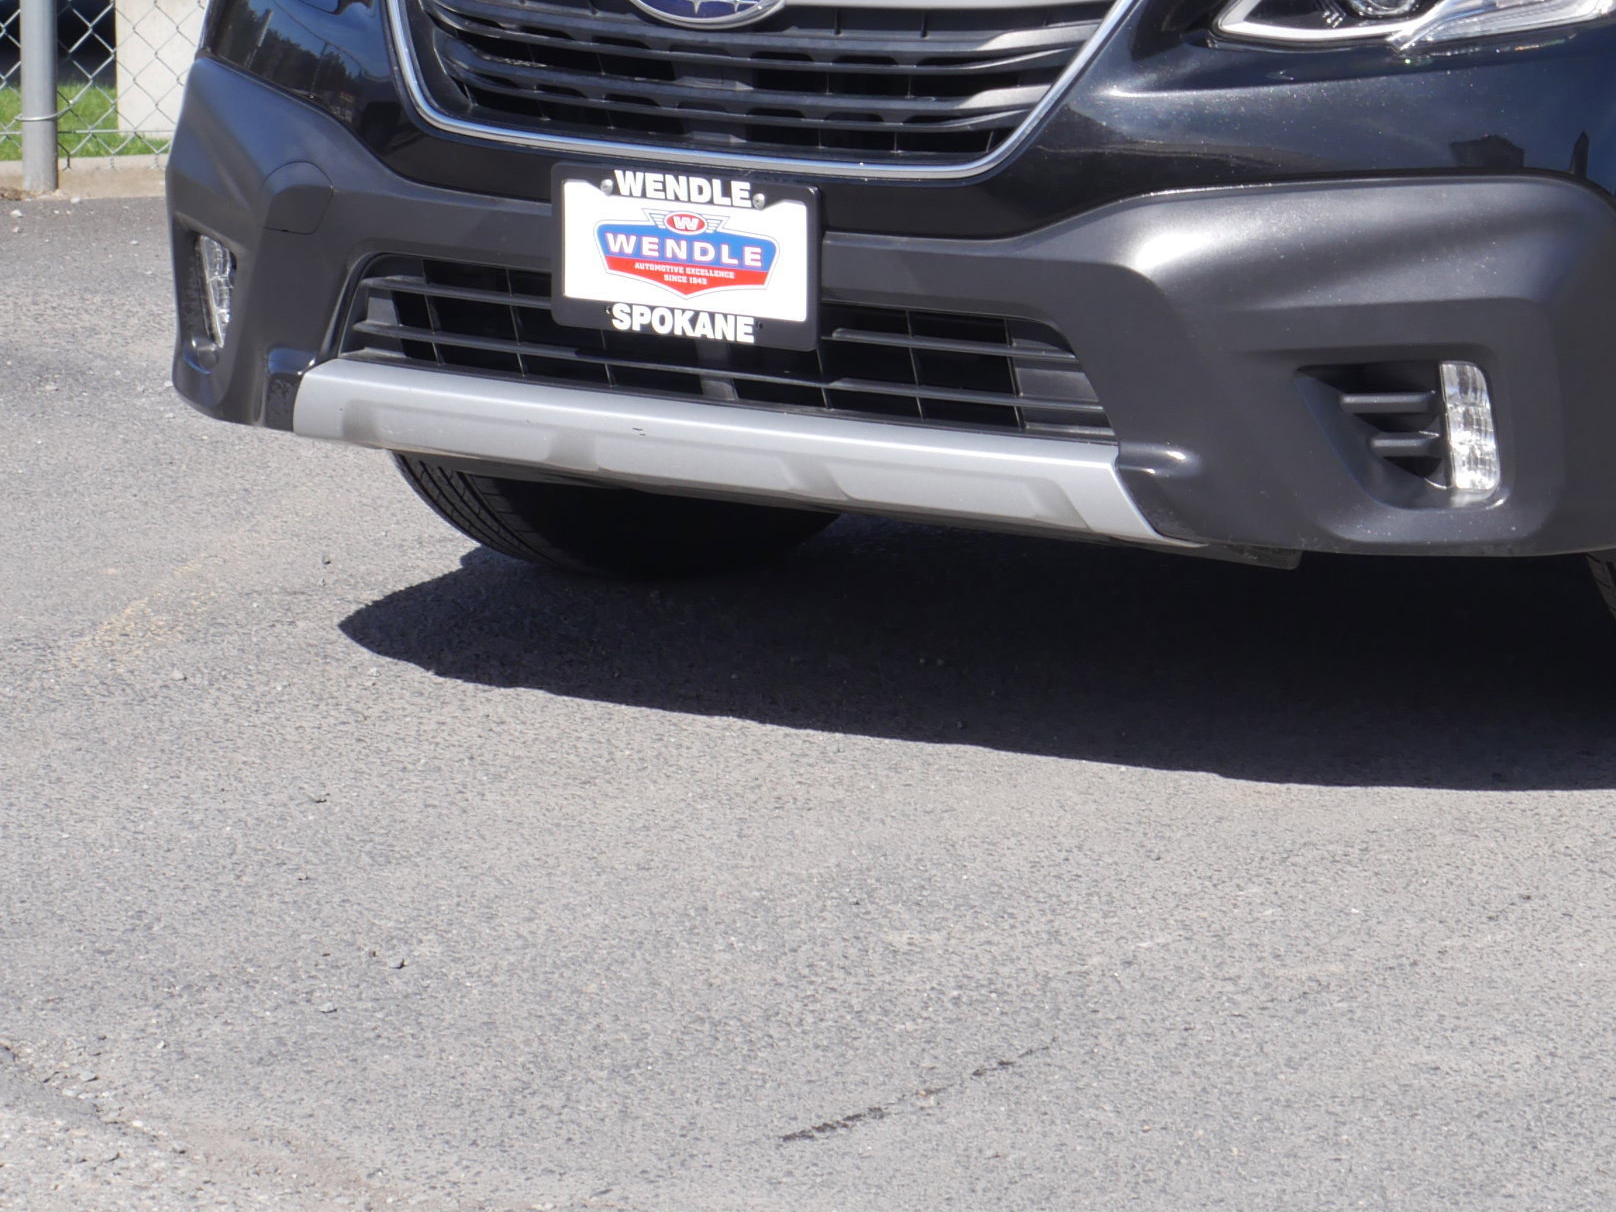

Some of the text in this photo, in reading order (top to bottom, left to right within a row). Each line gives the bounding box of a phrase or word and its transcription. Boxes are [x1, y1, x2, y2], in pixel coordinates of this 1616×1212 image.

[614, 169, 753, 207] WENDLE
[605, 232, 763, 268] WENDLE
[634, 261, 735, 279] AUTOMOTIVE EXCELLENCE
[663, 274, 688, 284] SINCE
[611, 302, 755, 344] SPOKANE
